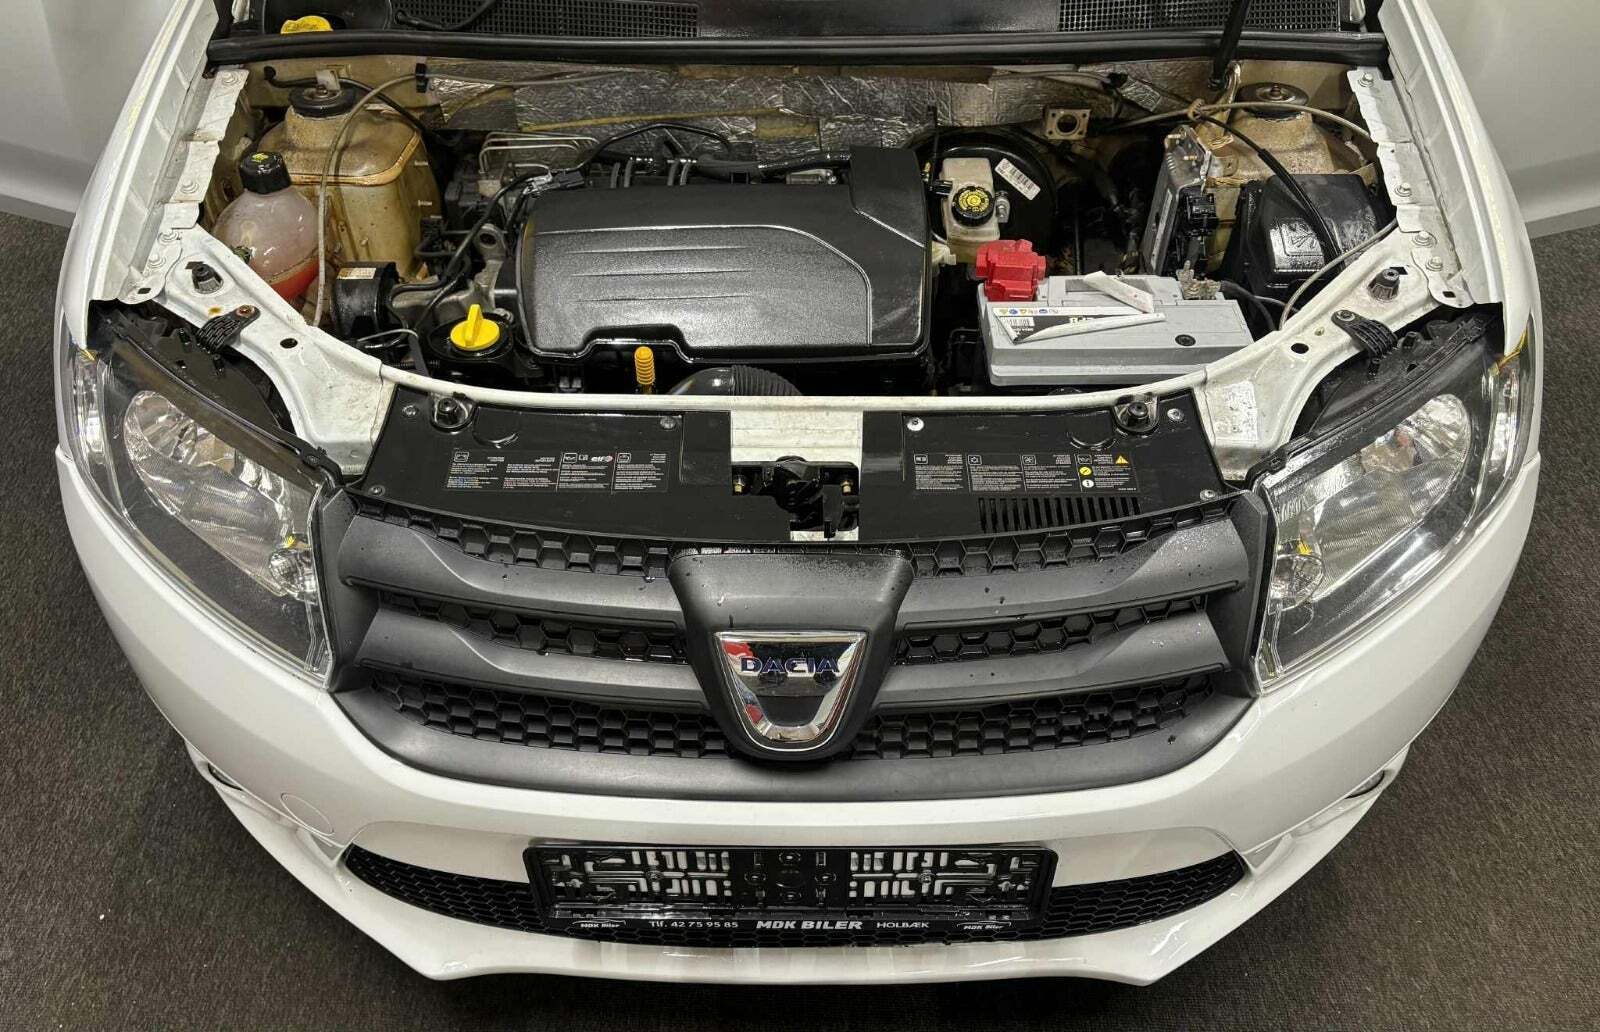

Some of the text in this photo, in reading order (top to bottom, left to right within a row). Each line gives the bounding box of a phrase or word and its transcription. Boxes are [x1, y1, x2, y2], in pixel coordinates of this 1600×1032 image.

[740, 656, 840, 673] DACIA
[756, 920, 863, 930] MDK BILER
